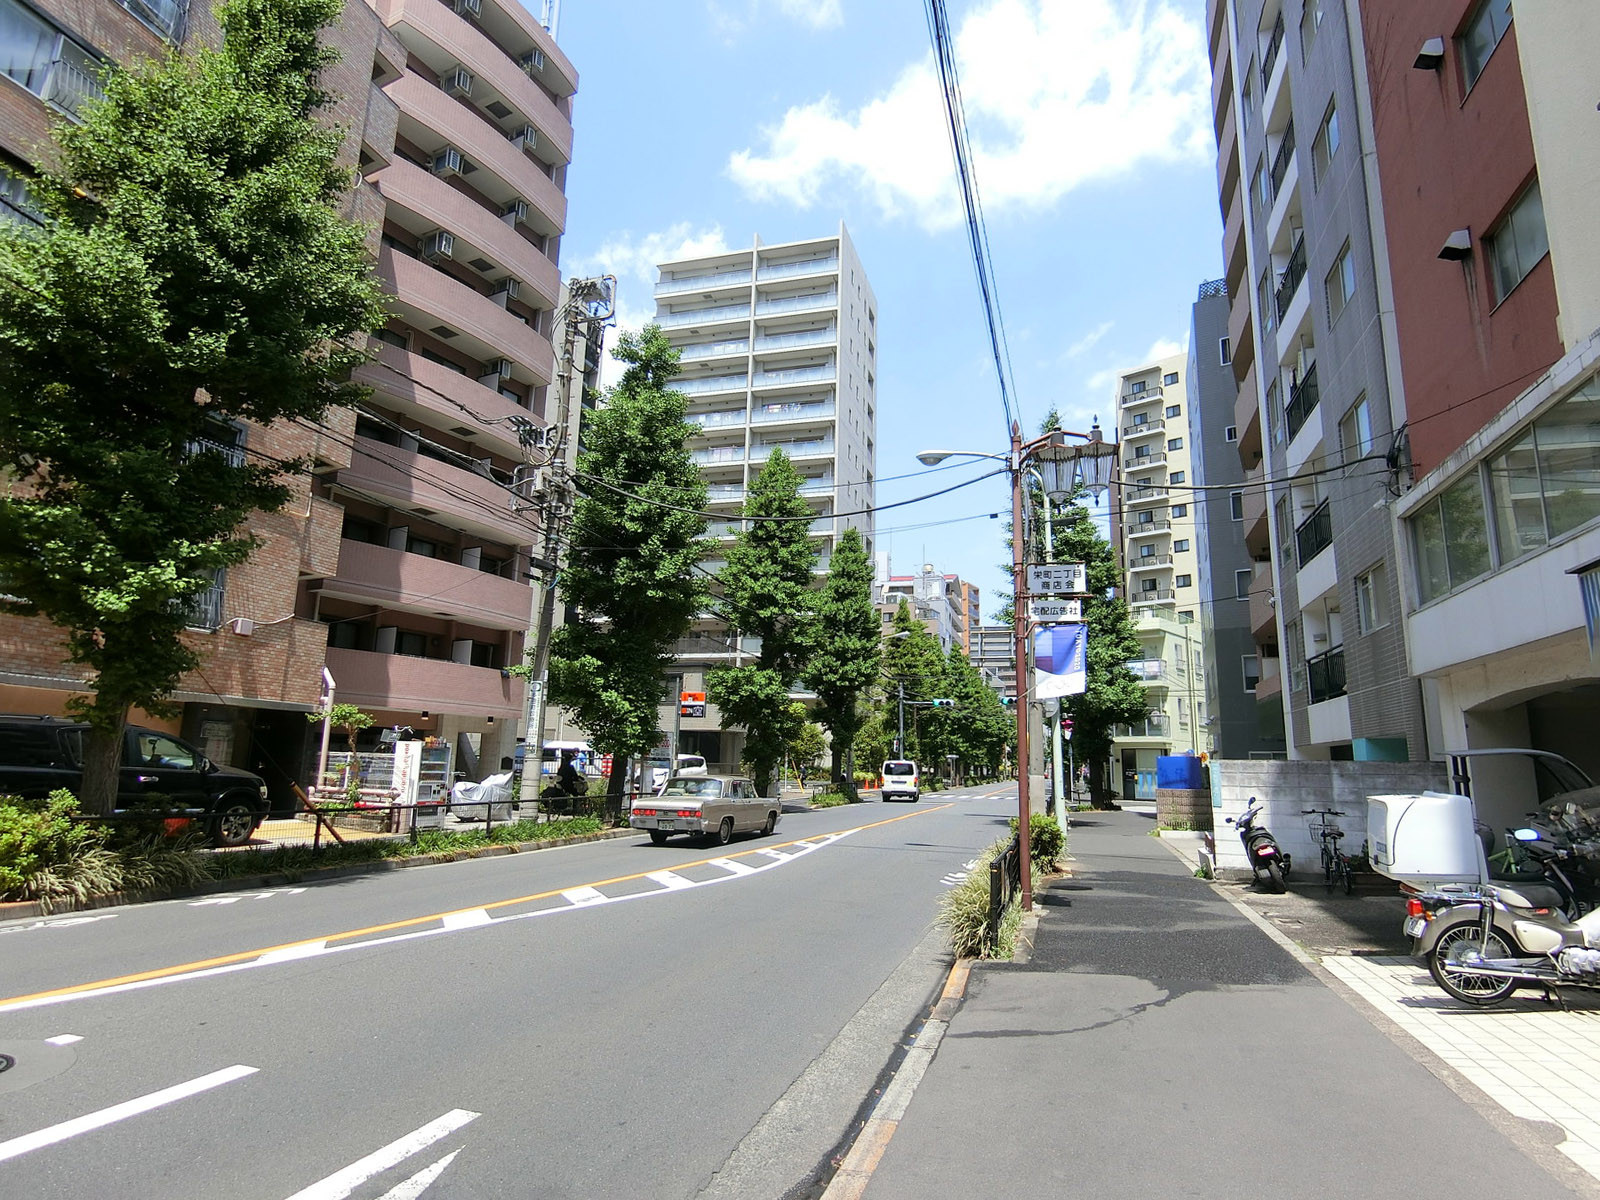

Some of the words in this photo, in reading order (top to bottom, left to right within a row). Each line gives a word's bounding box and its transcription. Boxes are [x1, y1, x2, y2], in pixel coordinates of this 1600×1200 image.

[1033, 569, 1081, 580] 栄町二丁目
[1041, 580, 1075, 590] 商店会
[1031, 606, 1079, 616] 宅配広告社
